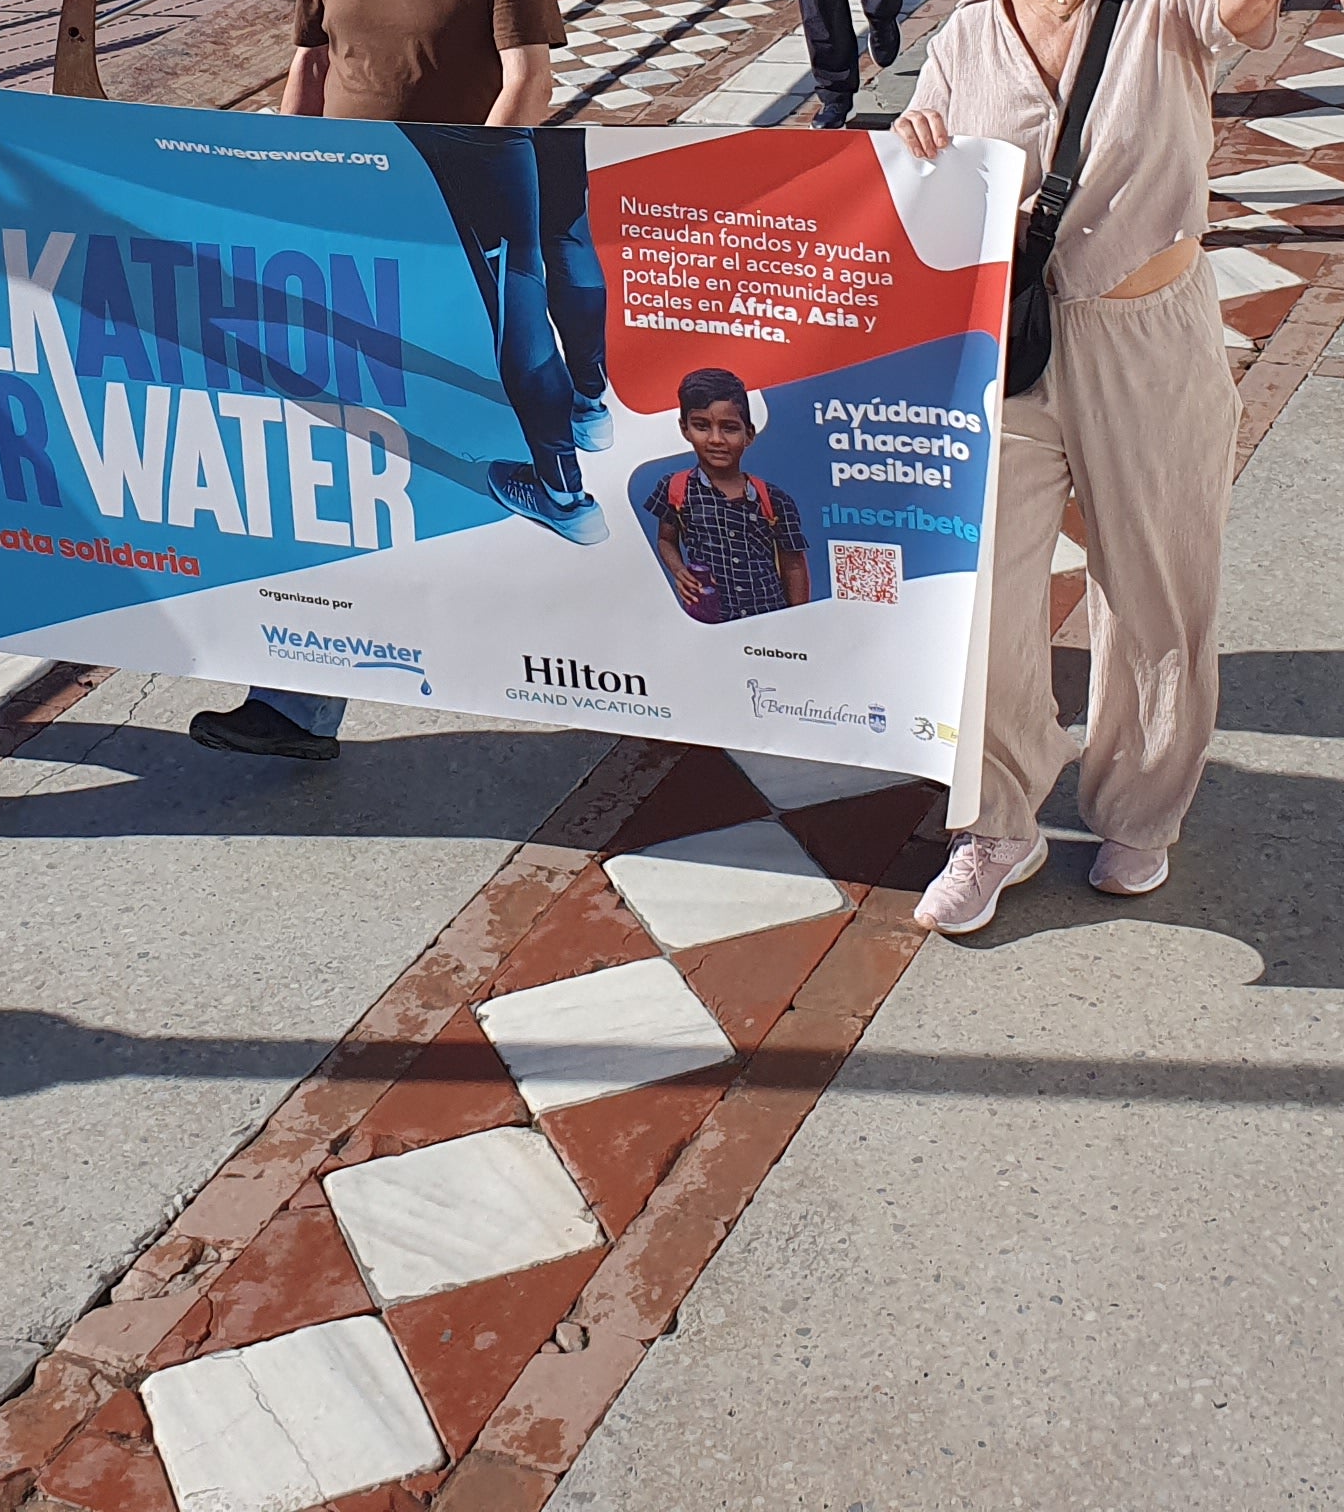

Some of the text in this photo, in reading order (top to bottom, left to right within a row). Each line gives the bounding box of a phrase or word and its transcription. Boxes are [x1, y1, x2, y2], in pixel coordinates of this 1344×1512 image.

[154, 138, 390, 172] www.wearewater.org
[621, 195, 818, 233] Nuestras caminatas
[621, 222, 891, 264] recaudan fondos y ayudan
[621, 245, 894, 288] a mejorar el acceso a agua
[623, 268, 879, 307] potable en comunidades
[624, 290, 877, 333] locales en África, Asia y
[624, 308, 791, 344] Latinoamérica.
[813, 397, 982, 433] ¡Ayúdanos
[828, 428, 970, 461] a hacerlo
[59, 380, 418, 551] WATER
[830, 458, 952, 488] posible!
[58, 537, 202, 577] solidaria
[259, 588, 353, 610] Organizado por
[261, 624, 423, 663] WeAreWater
[268, 645, 351, 668] Foundation
[743, 645, 808, 662] Colabora
[521, 654, 648, 697] Hilton
[505, 688, 672, 719] GRAND VACATIONS
[761, 699, 867, 726] Benalmádena
